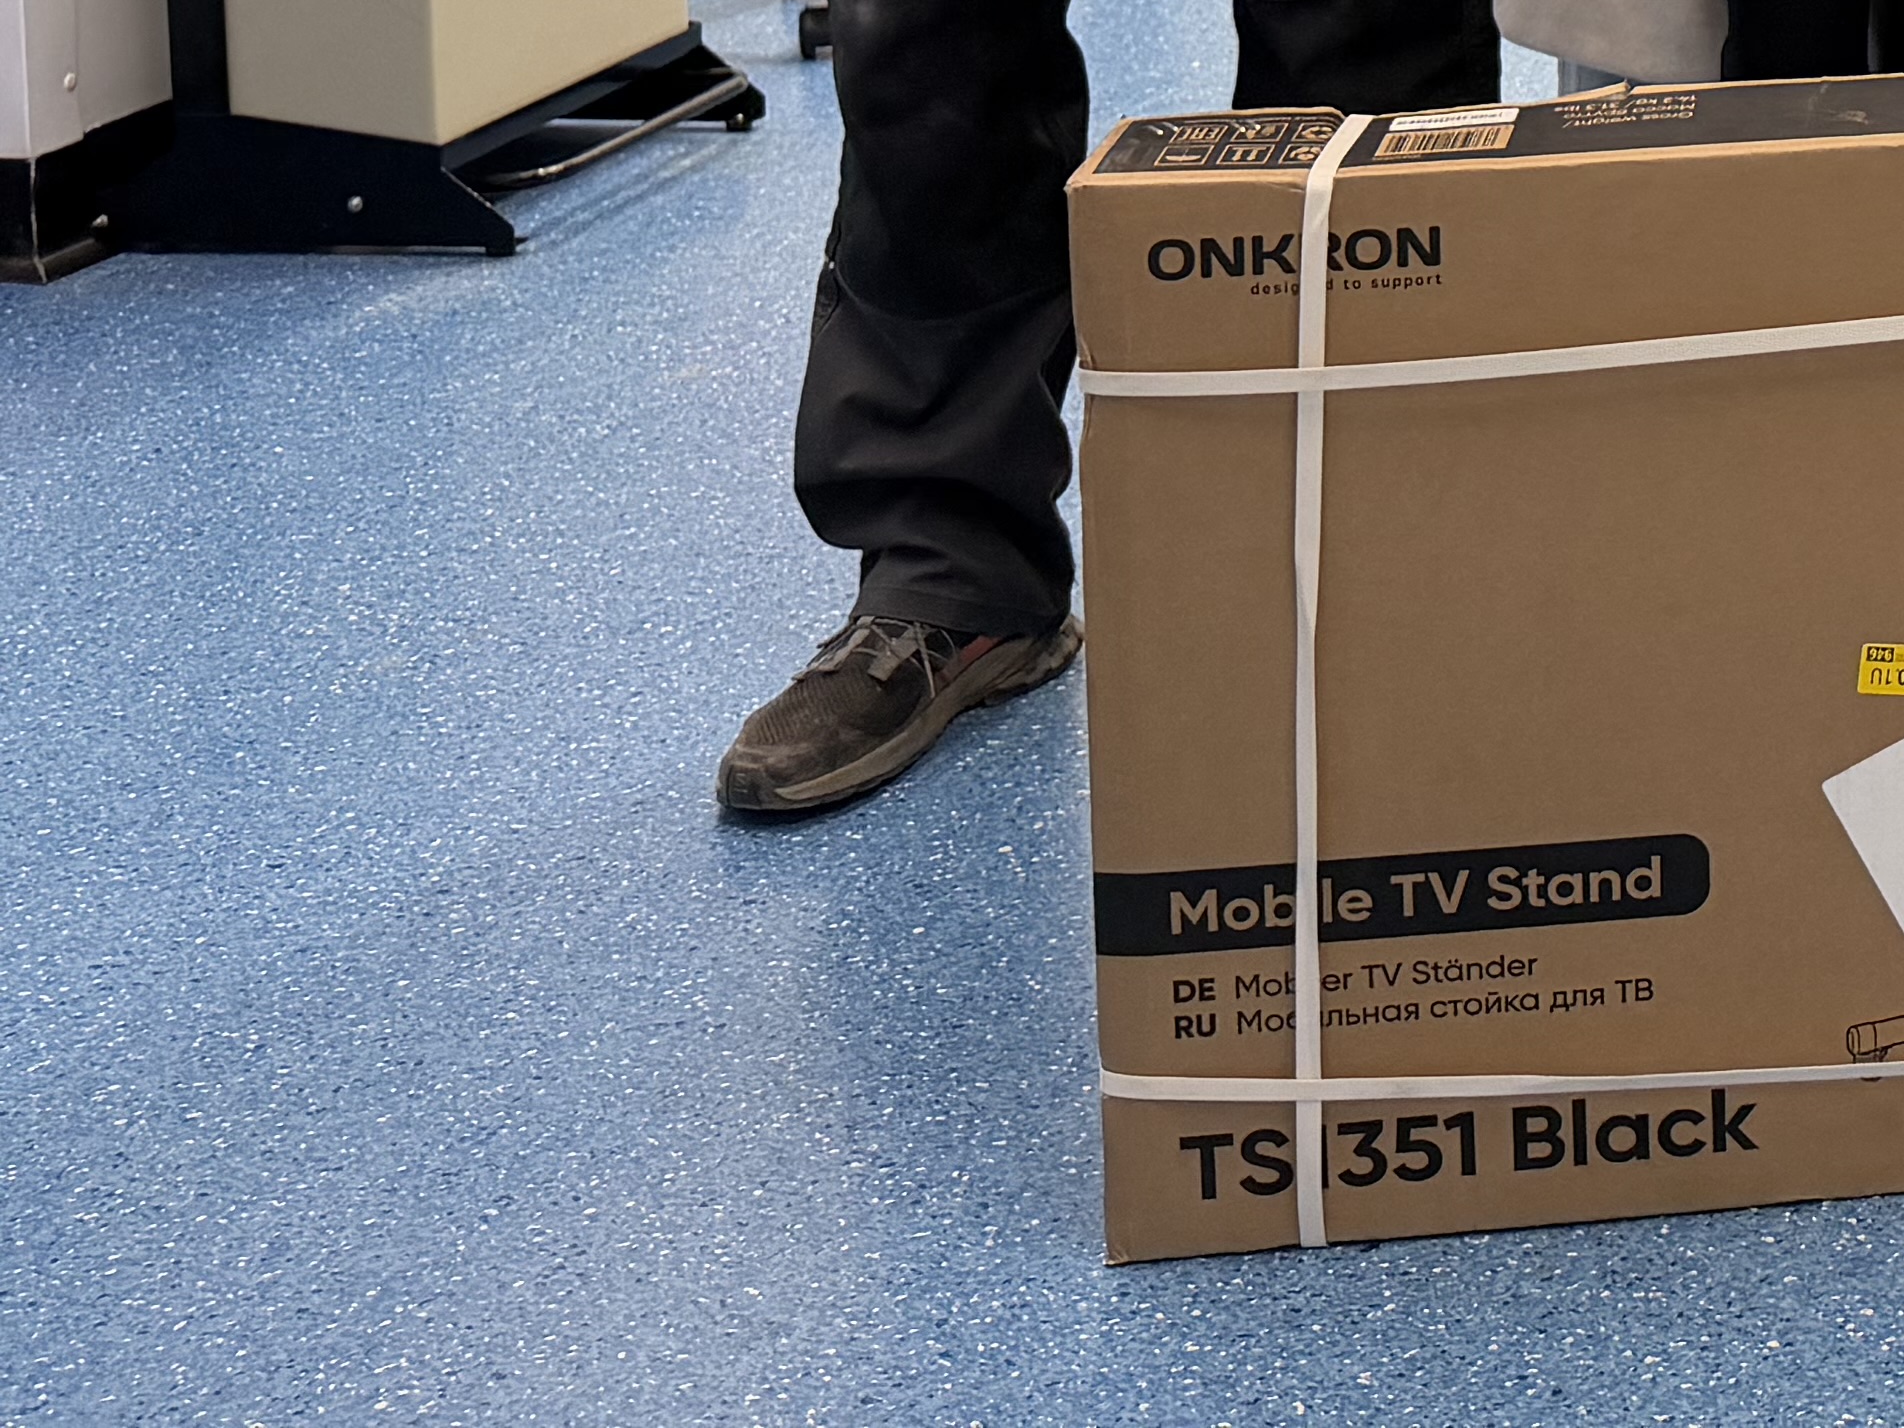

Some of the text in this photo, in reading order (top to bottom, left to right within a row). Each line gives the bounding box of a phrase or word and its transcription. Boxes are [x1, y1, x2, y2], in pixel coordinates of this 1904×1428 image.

[1250, 272, 1444, 298] desigd to support
[1169, 855, 1662, 936] Moble TV Stand
[1172, 954, 1539, 1004] DE Mober TV Ständer
[1236, 976, 1655, 1037] Мобльная стойка для ТВ
[1174, 1012, 1217, 1040] RU
[1510, 1087, 1761, 1173] Black
